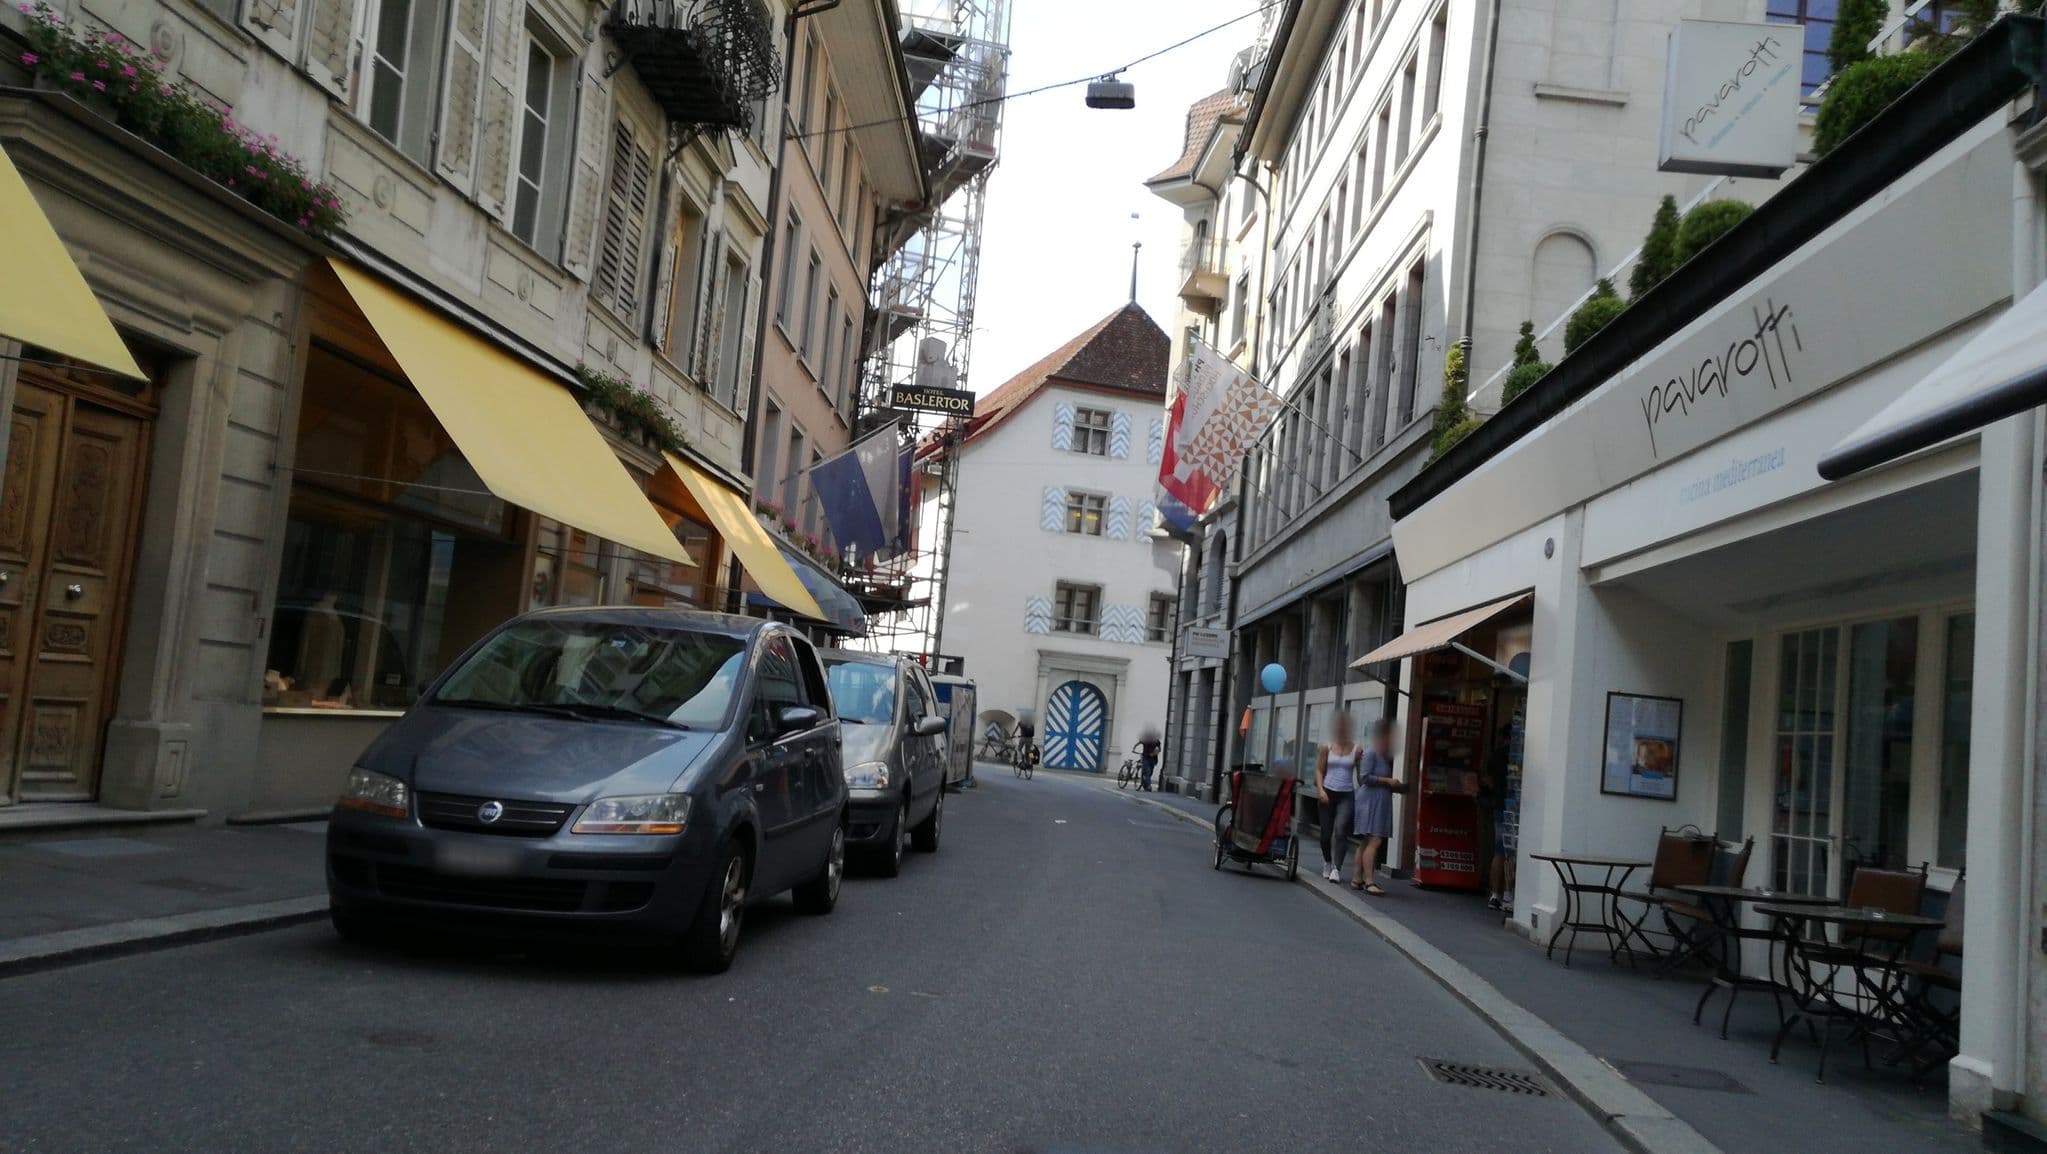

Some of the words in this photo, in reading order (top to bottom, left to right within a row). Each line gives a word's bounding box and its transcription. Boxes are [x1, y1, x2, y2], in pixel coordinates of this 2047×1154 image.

[1680, 36, 1781, 145] pavarotti
[895, 392, 969, 411] BASLERTOR
[1640, 297, 1803, 459] pavarotti
